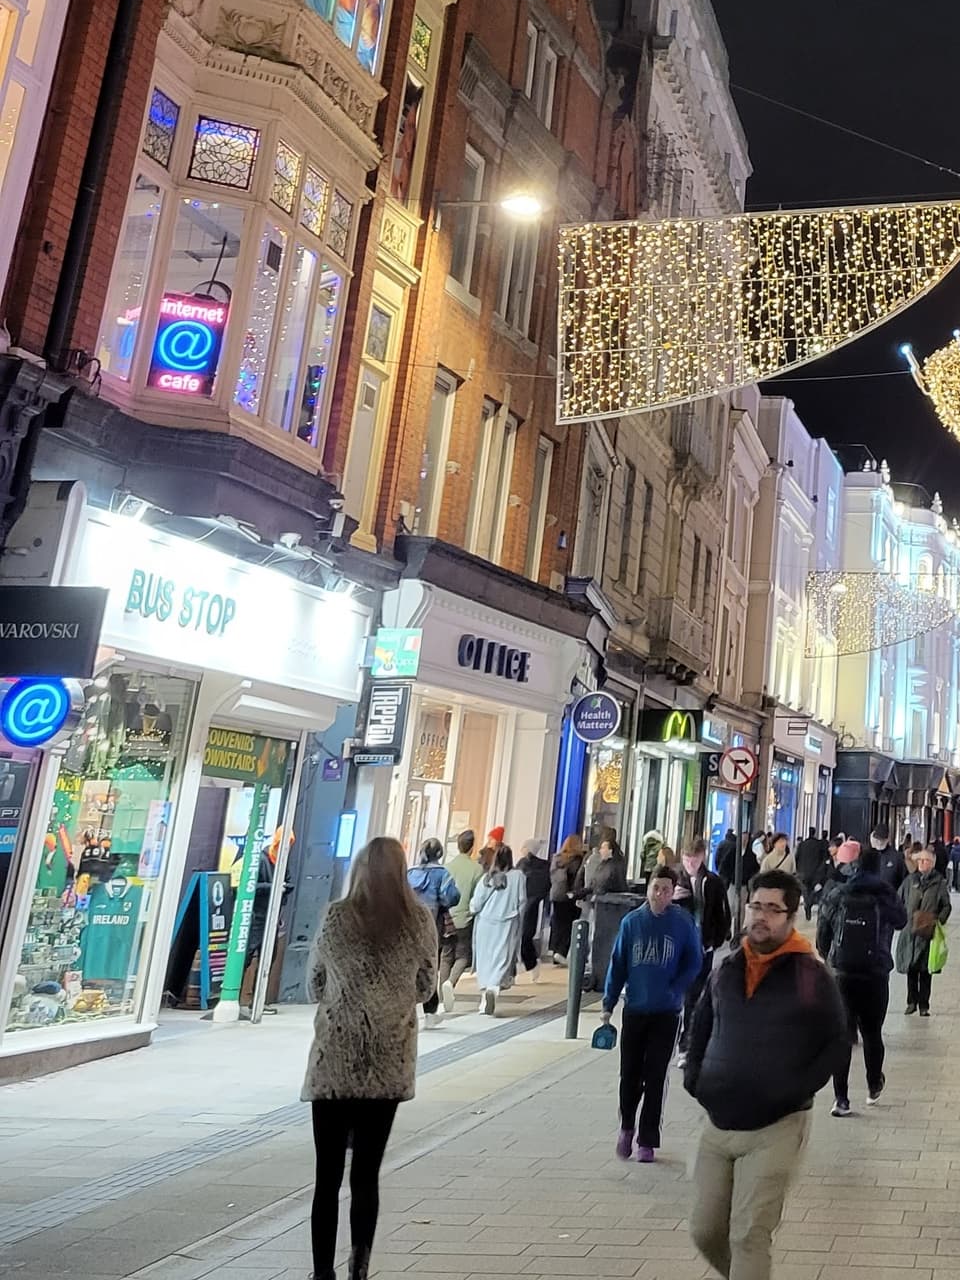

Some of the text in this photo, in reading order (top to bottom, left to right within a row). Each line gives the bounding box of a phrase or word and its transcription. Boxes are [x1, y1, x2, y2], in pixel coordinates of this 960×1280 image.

[160, 298, 225, 323] internet
[159, 374, 200, 391] cafe
[125, 568, 237, 637] BUS STOP
[457, 633, 532, 683] OFFICE
[577, 720, 614, 730] Matters
[580, 710, 611, 721] Health
[209, 730, 256, 752] OUVENIRS
[204, 748, 258, 772] OWNSTAIRS
[92, 915, 130, 925] IRELAND
[236, 899, 254, 953] HERE
